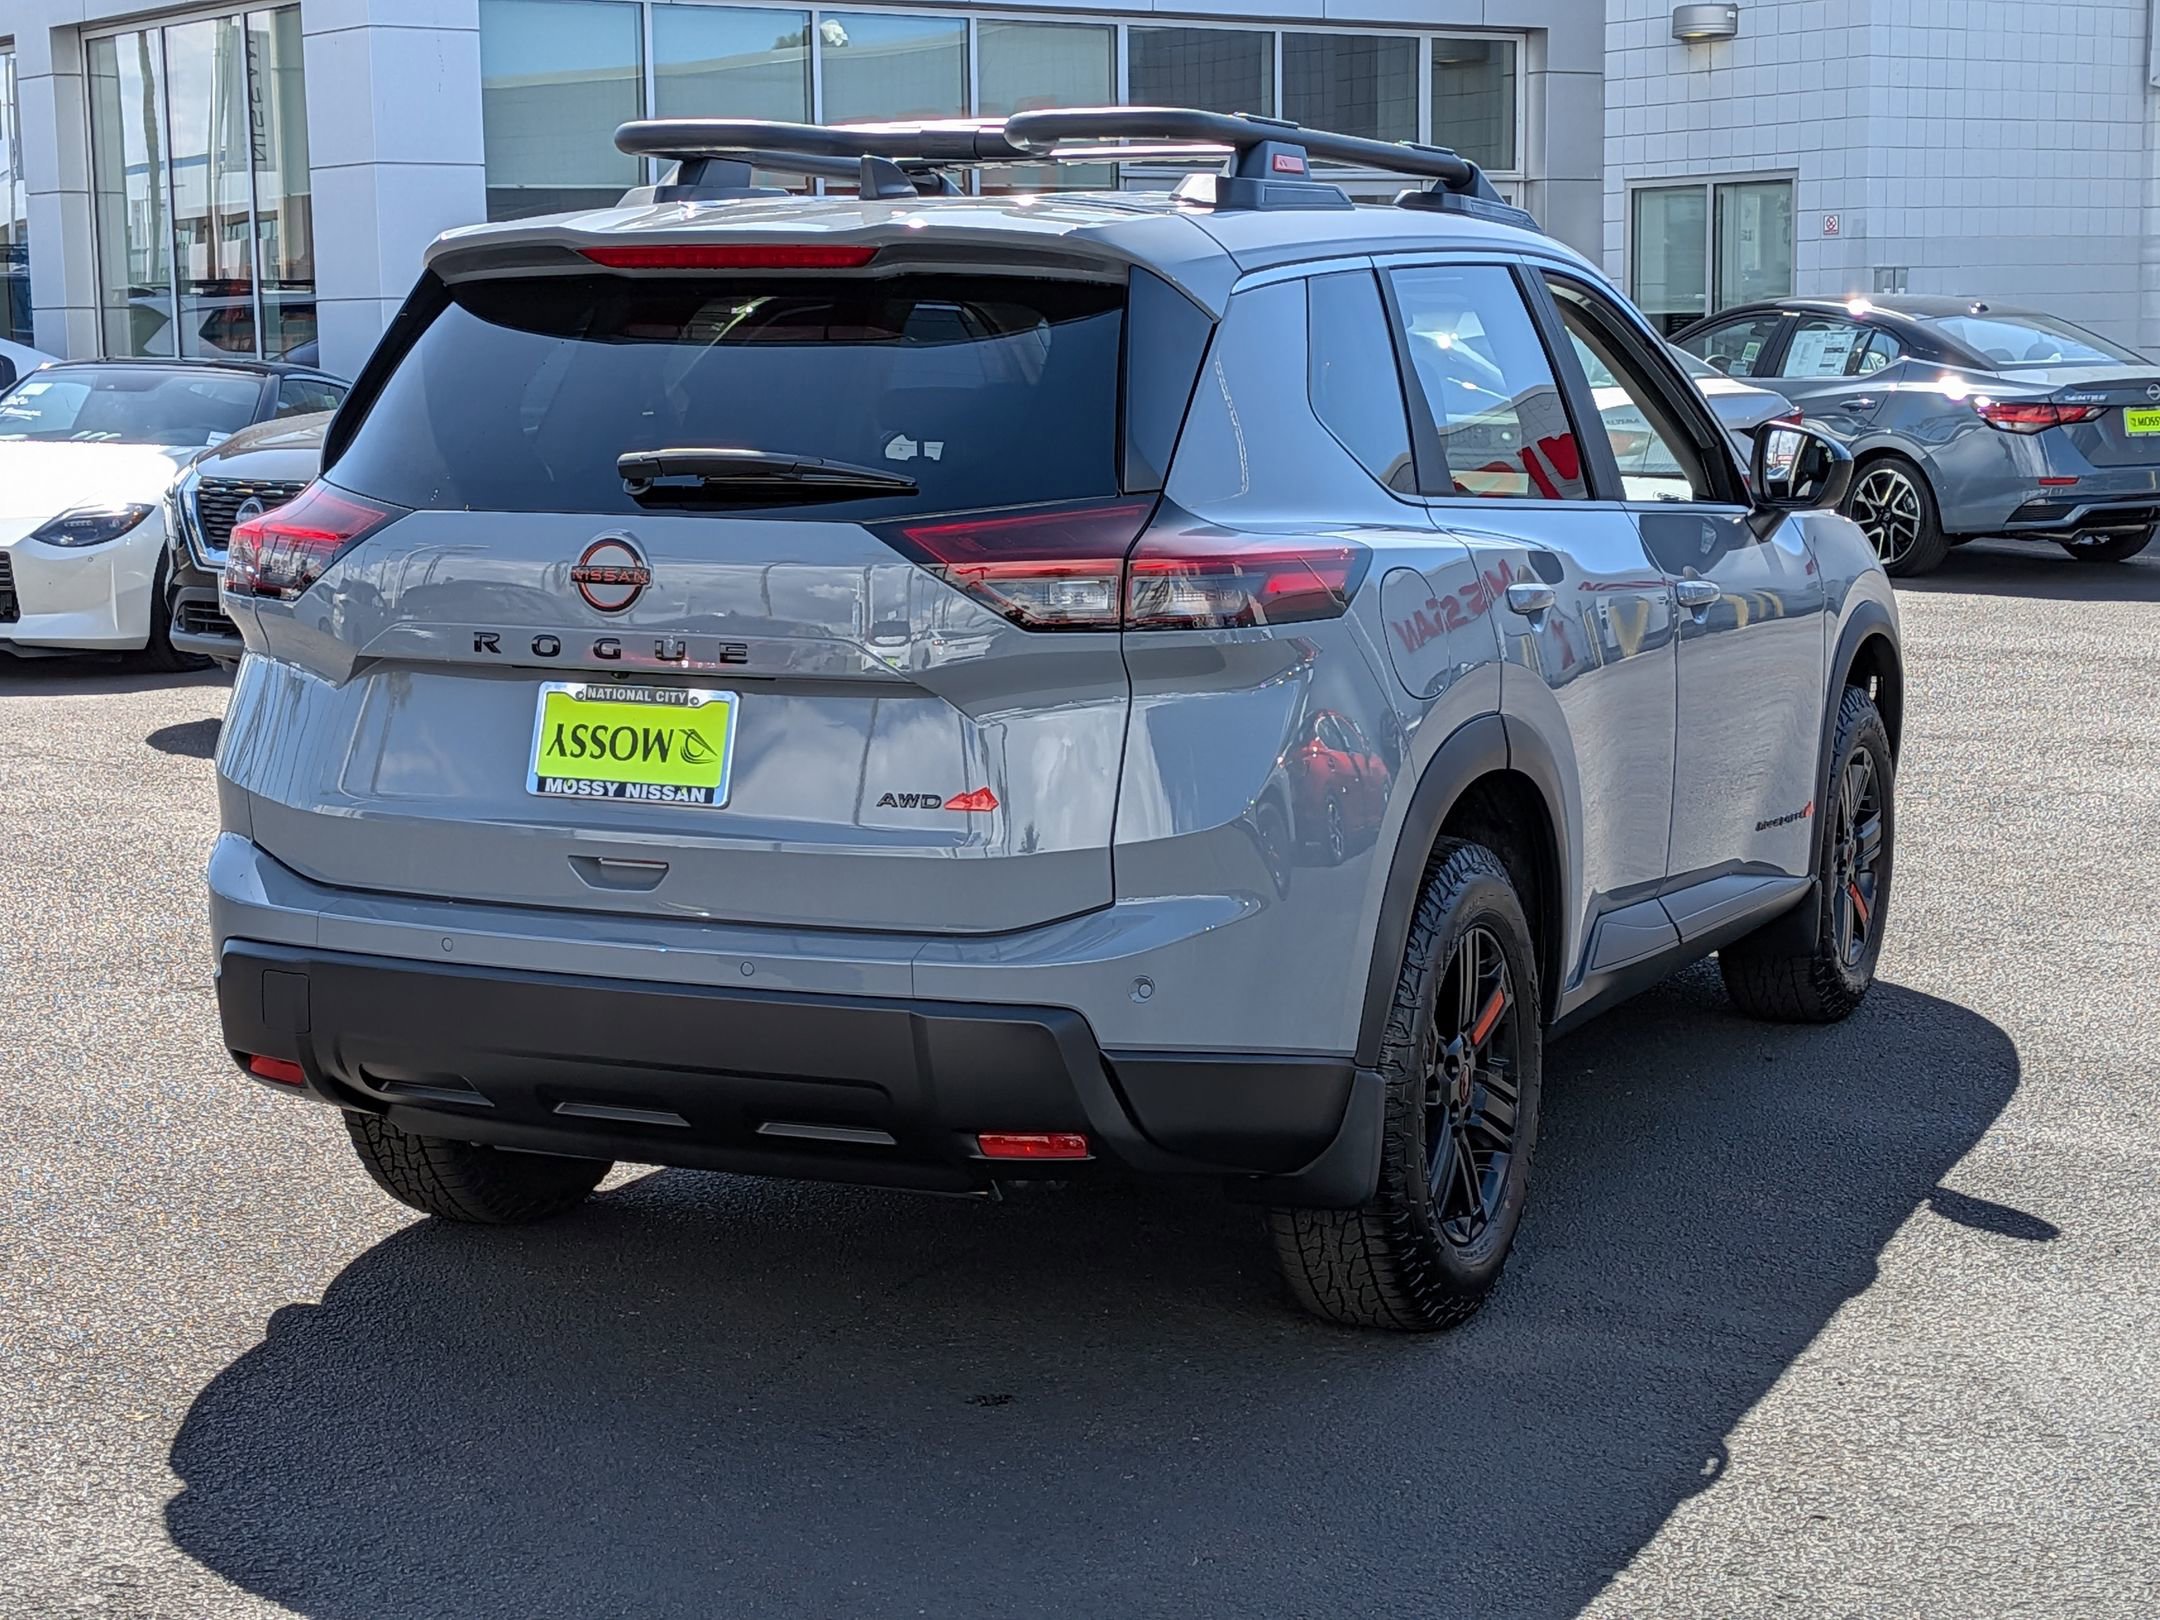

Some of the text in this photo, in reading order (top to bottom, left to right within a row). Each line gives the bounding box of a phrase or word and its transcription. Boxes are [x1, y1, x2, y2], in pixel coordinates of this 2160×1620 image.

[573, 568, 649, 583] NISSAN
[473, 631, 749, 665] ROGUE
[586, 686, 687, 704] NATIONAL CITY
[546, 723, 674, 763] MOSSY
[544, 778, 706, 803] MOSSY NISSAN
[876, 792, 942, 809] AWD
